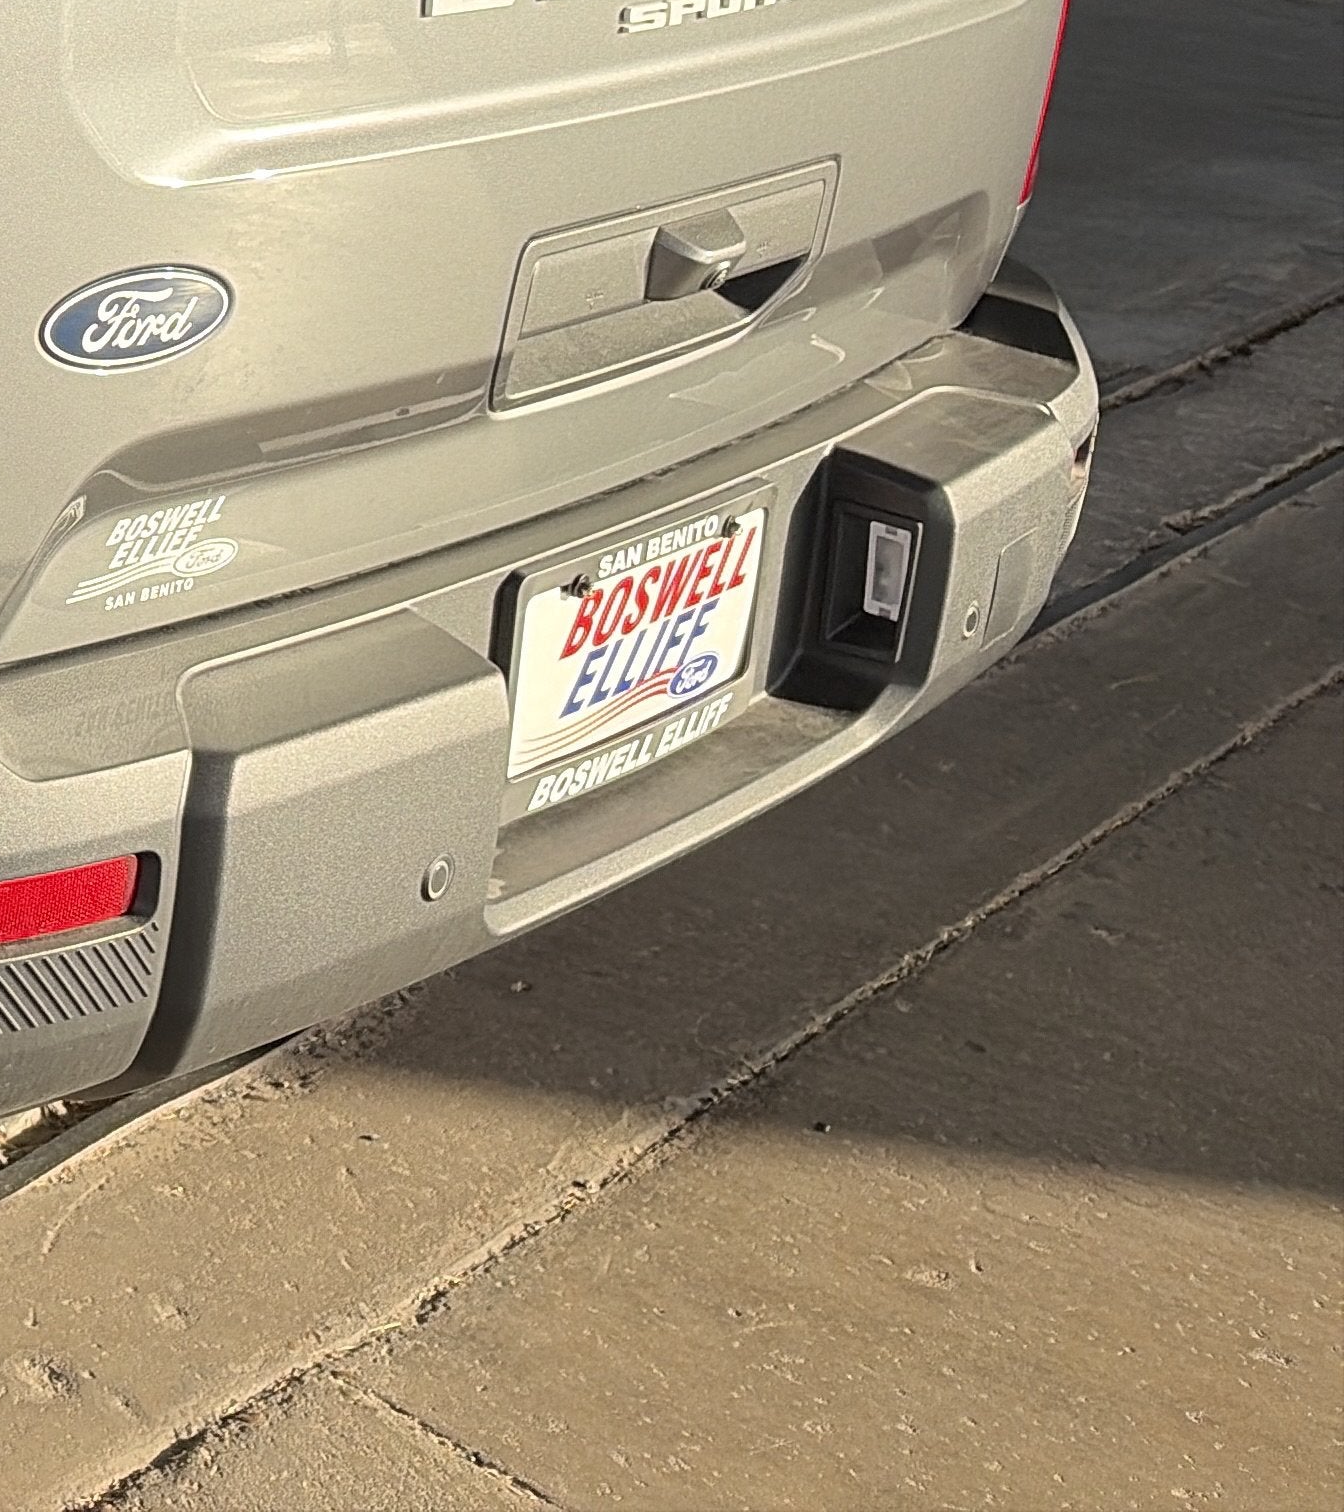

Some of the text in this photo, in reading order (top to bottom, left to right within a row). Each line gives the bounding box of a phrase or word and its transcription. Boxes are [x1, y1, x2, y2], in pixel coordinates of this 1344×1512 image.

[105, 495, 226, 547] BOSWELL
[108, 524, 204, 569] ELLIFF
[597, 514, 719, 579] SAN BENITO
[104, 577, 194, 611] SAN BENITO
[559, 527, 758, 661] BOSWELL
[559, 598, 721, 719] ELLIFF
[527, 692, 734, 812] BOSWELL ELLIFF
